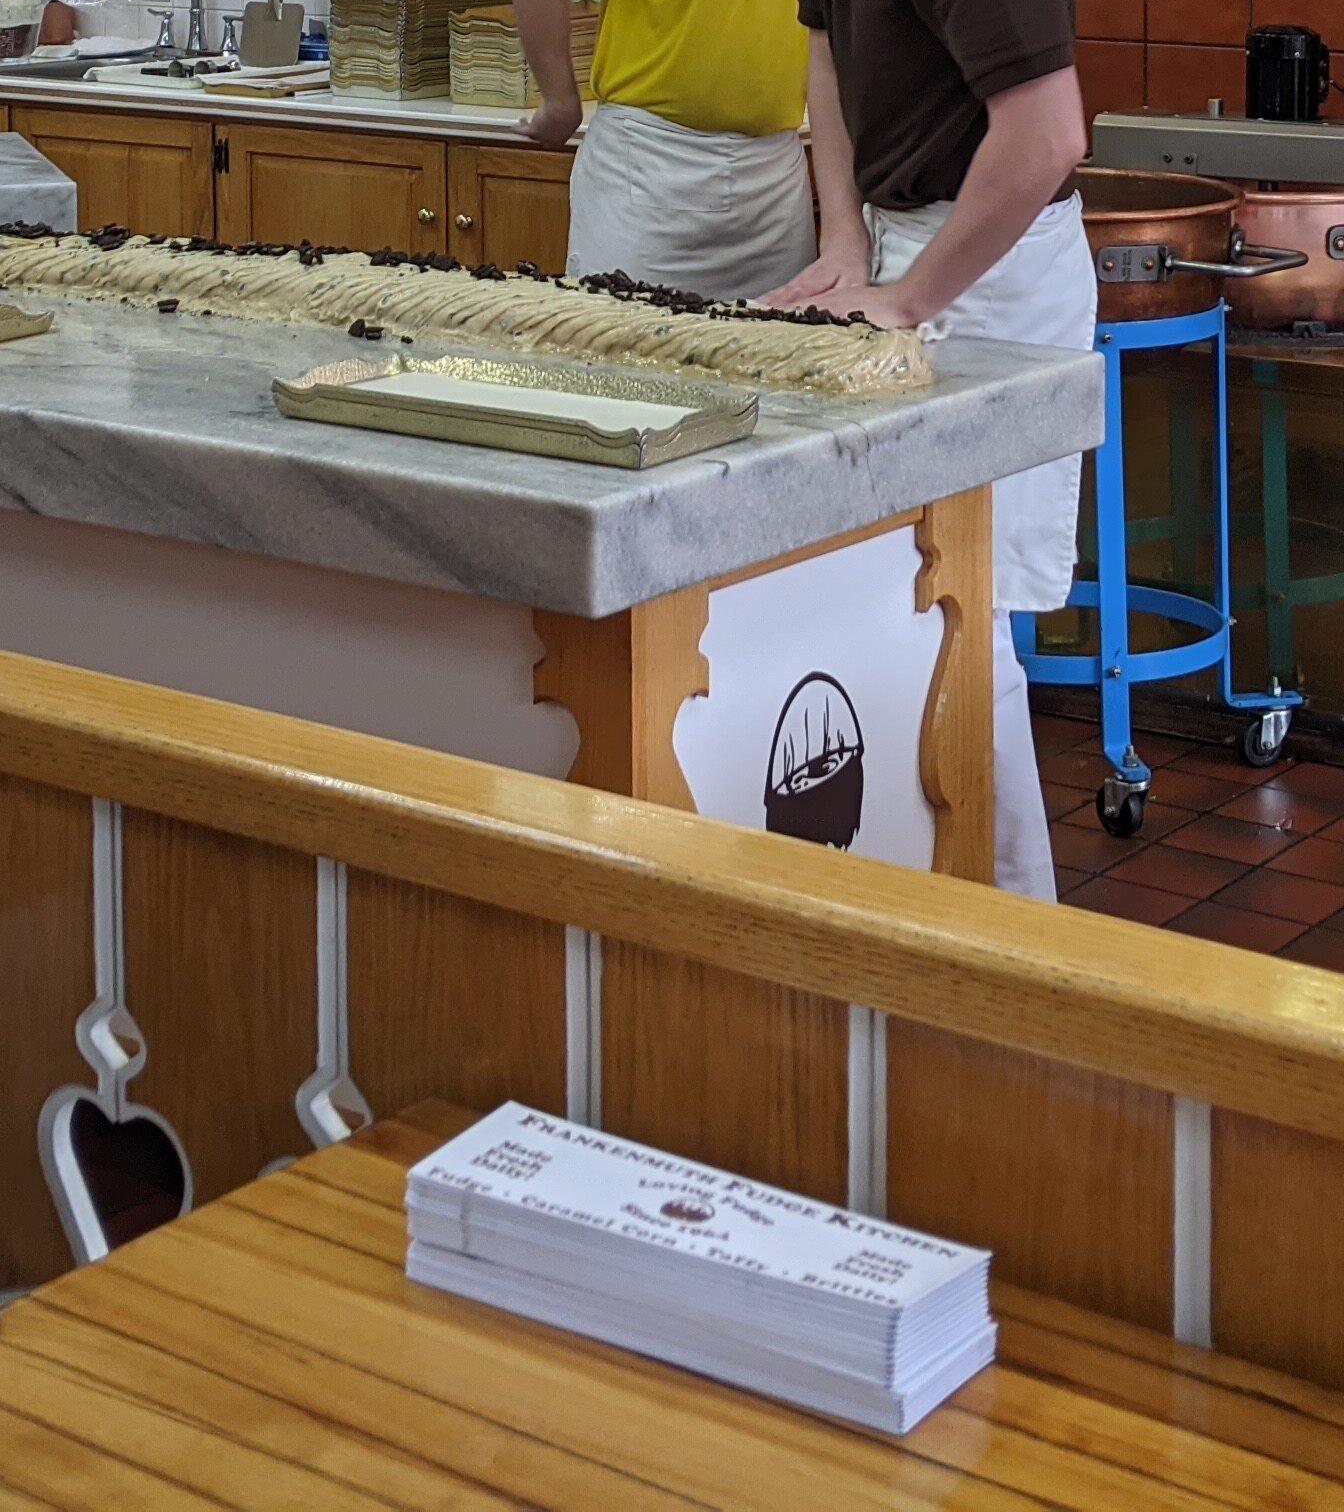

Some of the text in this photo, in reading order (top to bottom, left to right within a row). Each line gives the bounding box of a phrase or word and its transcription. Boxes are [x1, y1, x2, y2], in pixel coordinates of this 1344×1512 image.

[486, 1148, 545, 1172] Fresh
[502, 1140, 554, 1164] Made
[517, 1113, 959, 1259] FRANKENMUTH FUDGE KITCHEN
[638, 1177, 716, 1201] Loving
[427, 1166, 900, 1306] Fudge Caramel Corn Taffy Brittles
